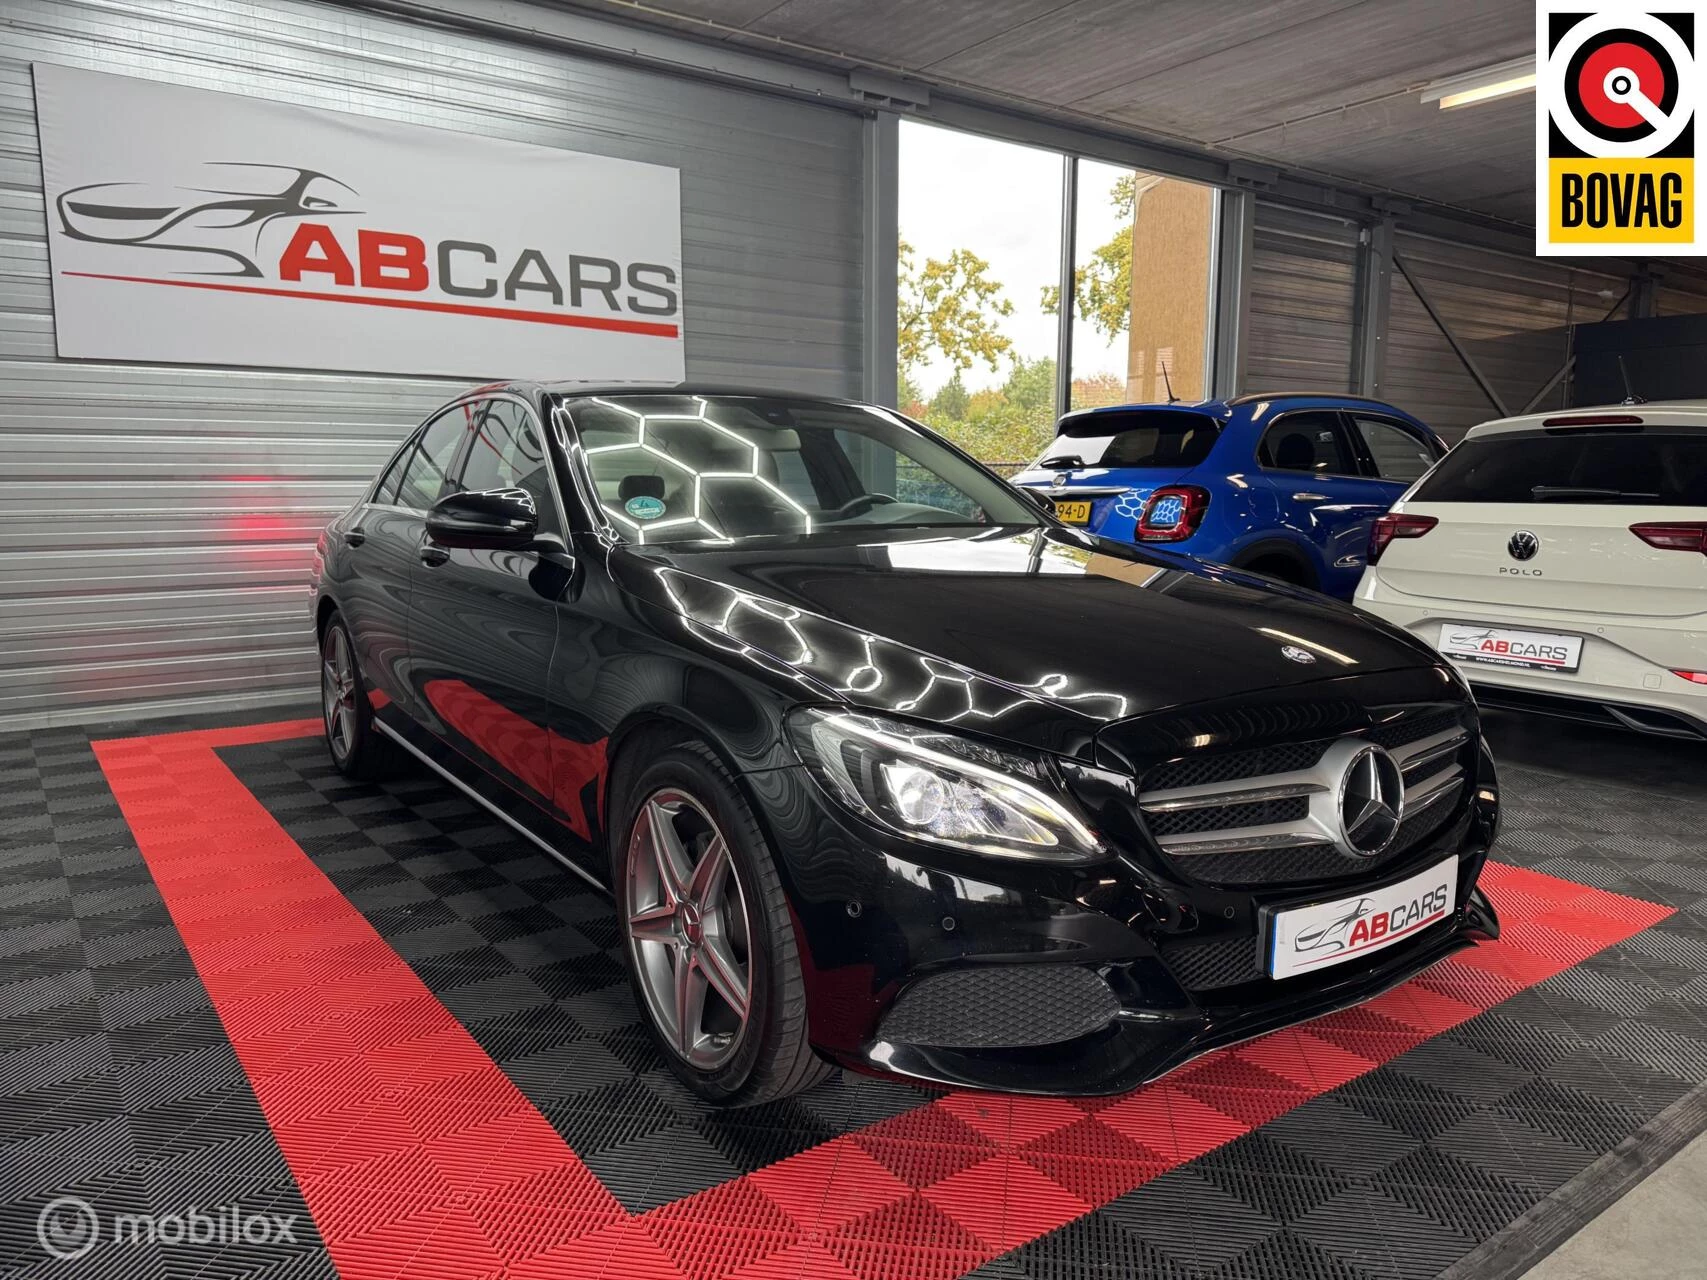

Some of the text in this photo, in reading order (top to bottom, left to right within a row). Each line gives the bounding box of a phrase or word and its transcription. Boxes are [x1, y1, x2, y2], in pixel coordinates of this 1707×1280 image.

[279, 222, 678, 317] ABCARS
[1056, 503, 1086, 519] 94-D
[1499, 566, 1543, 577] POLO
[1480, 639, 1568, 661] ABCARS
[1349, 883, 1448, 948] ABCARS
